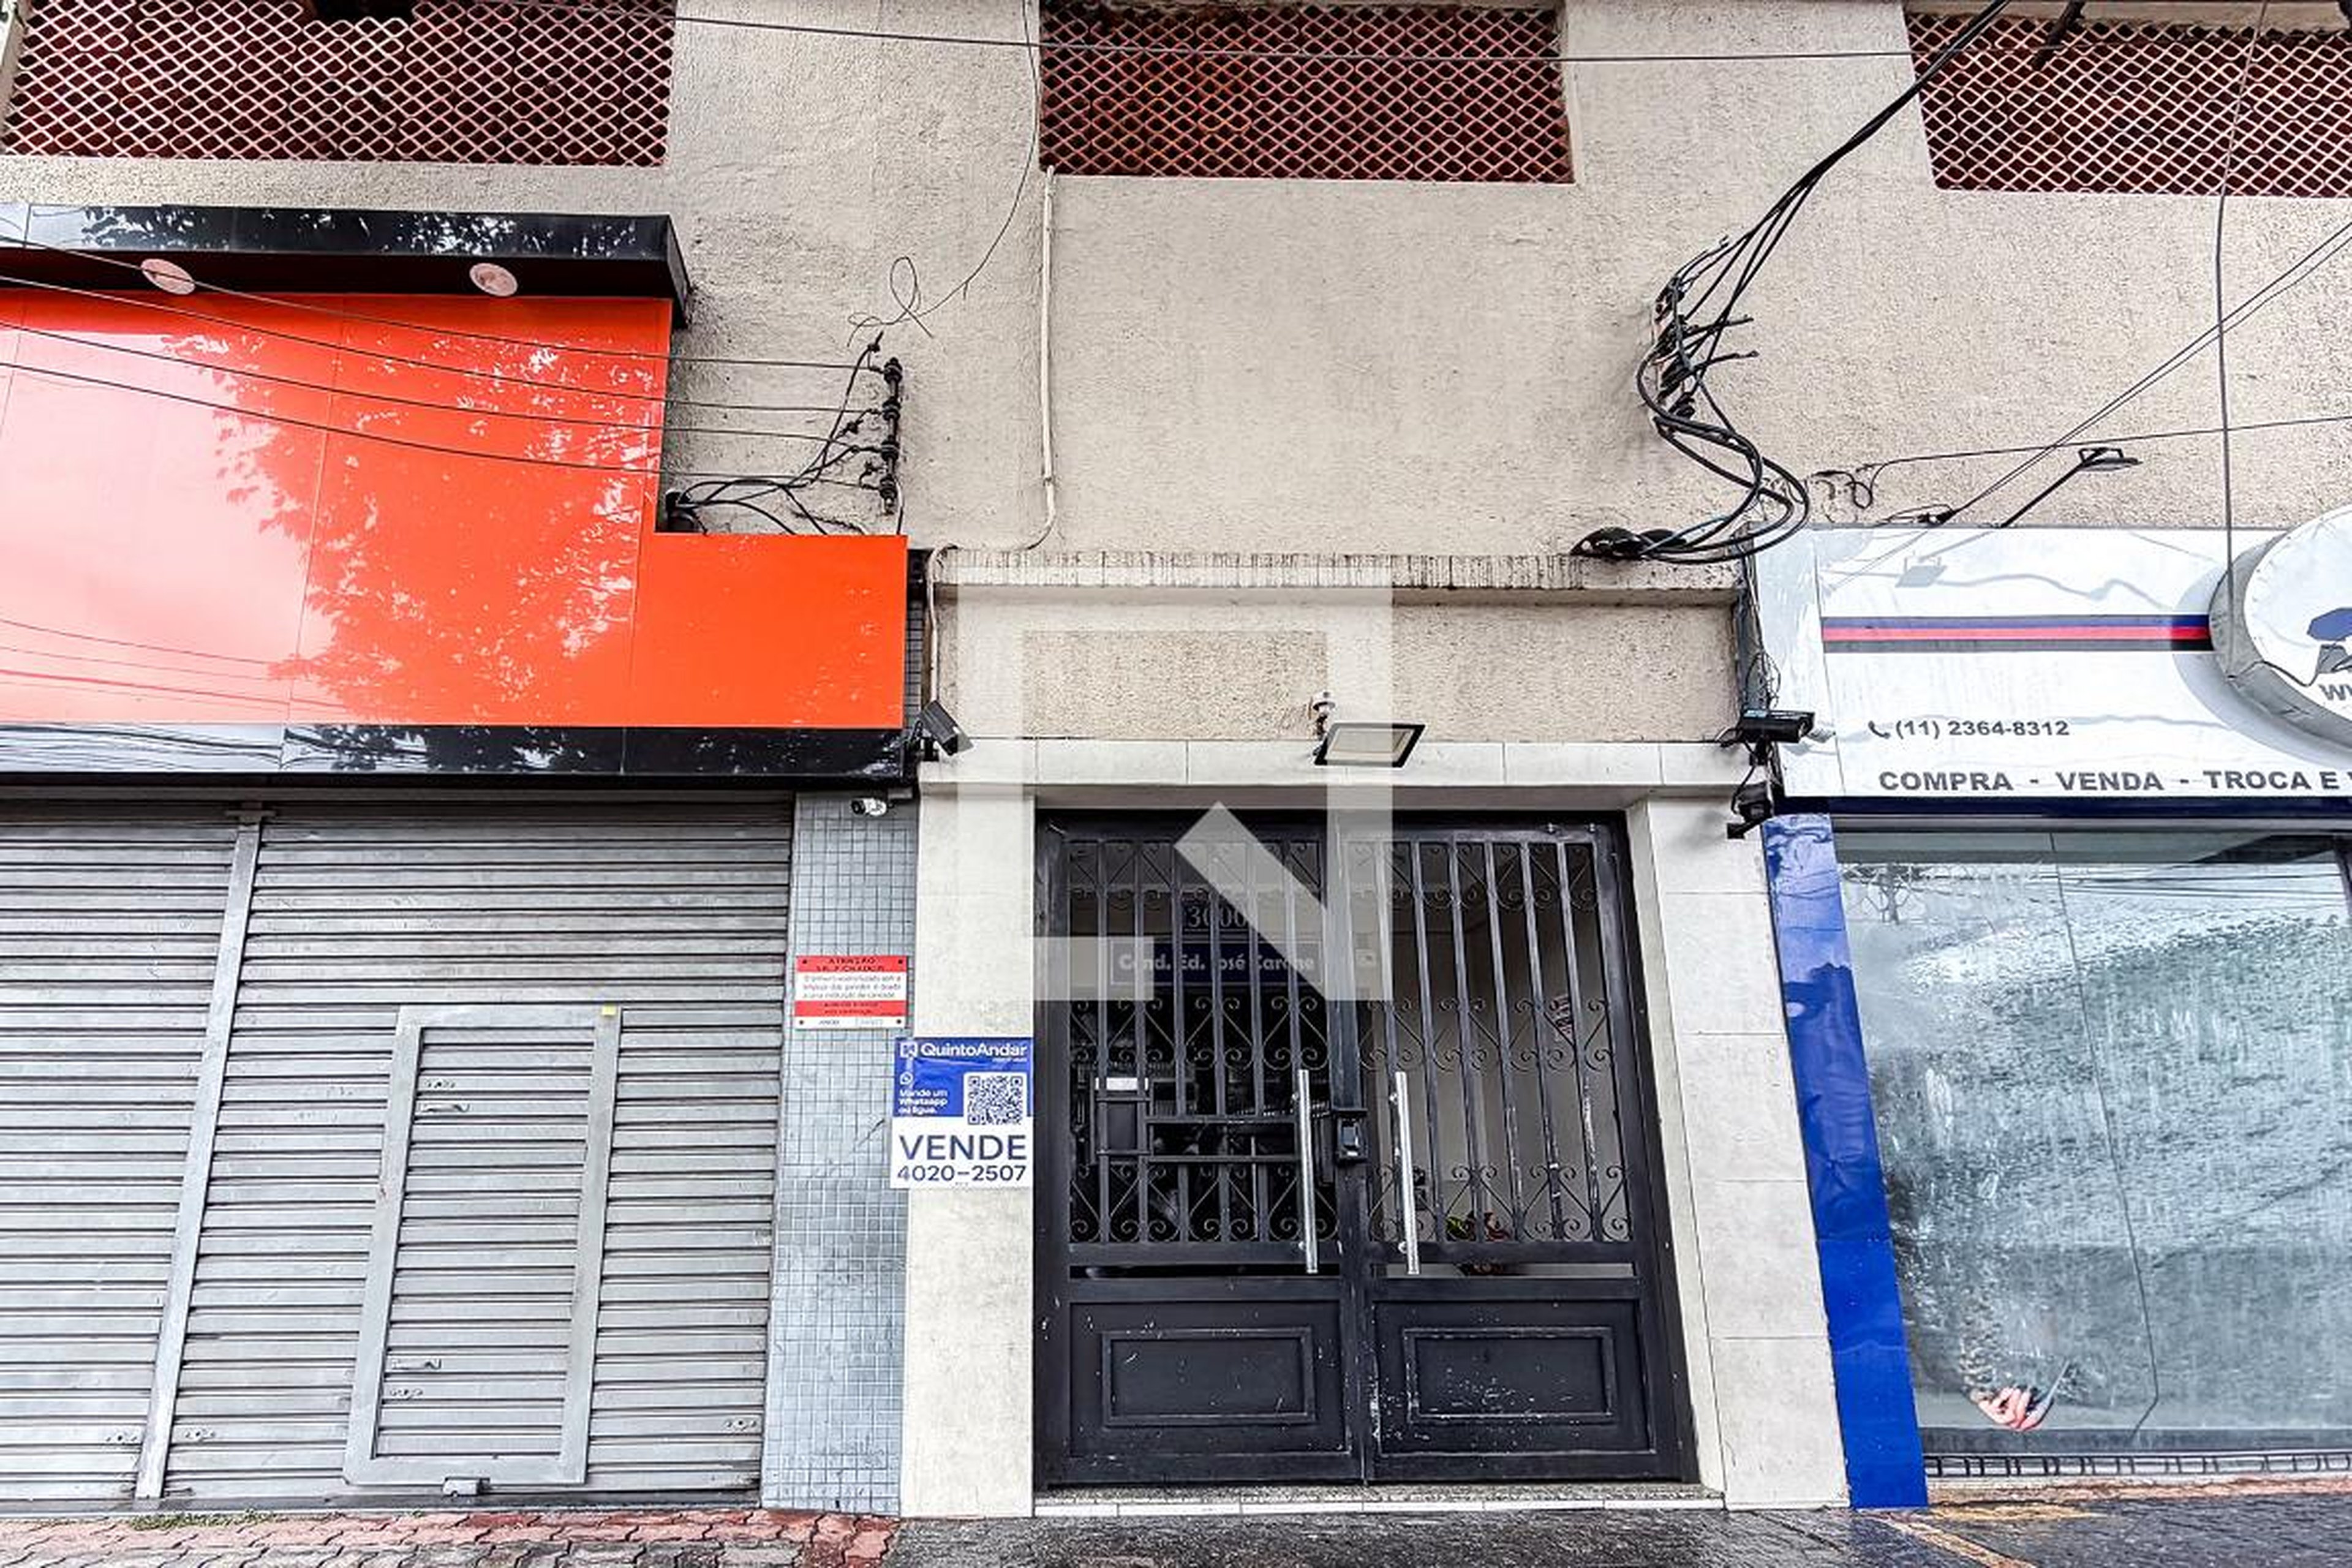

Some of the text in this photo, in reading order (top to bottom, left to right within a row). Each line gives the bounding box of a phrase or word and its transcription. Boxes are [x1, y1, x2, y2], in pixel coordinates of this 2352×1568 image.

[1896, 721, 2070, 739] (11) 2364-8312
[1879, 772, 2014, 791] COMPRA
[2056, 772, 2163, 791] VENDA
[2203, 771, 2312, 790] TROCA
[2319, 771, 2340, 790] E
[1119, 953, 1171, 970] Cnd.
[1180, 953, 1206, 970] Ed.
[1215, 952, 1245, 971] osé
[921, 1042, 1028, 1057] QuintoAndar
[899, 1134, 1027, 1160] VENDE
[897, 1165, 1027, 1182] 4020-2507
